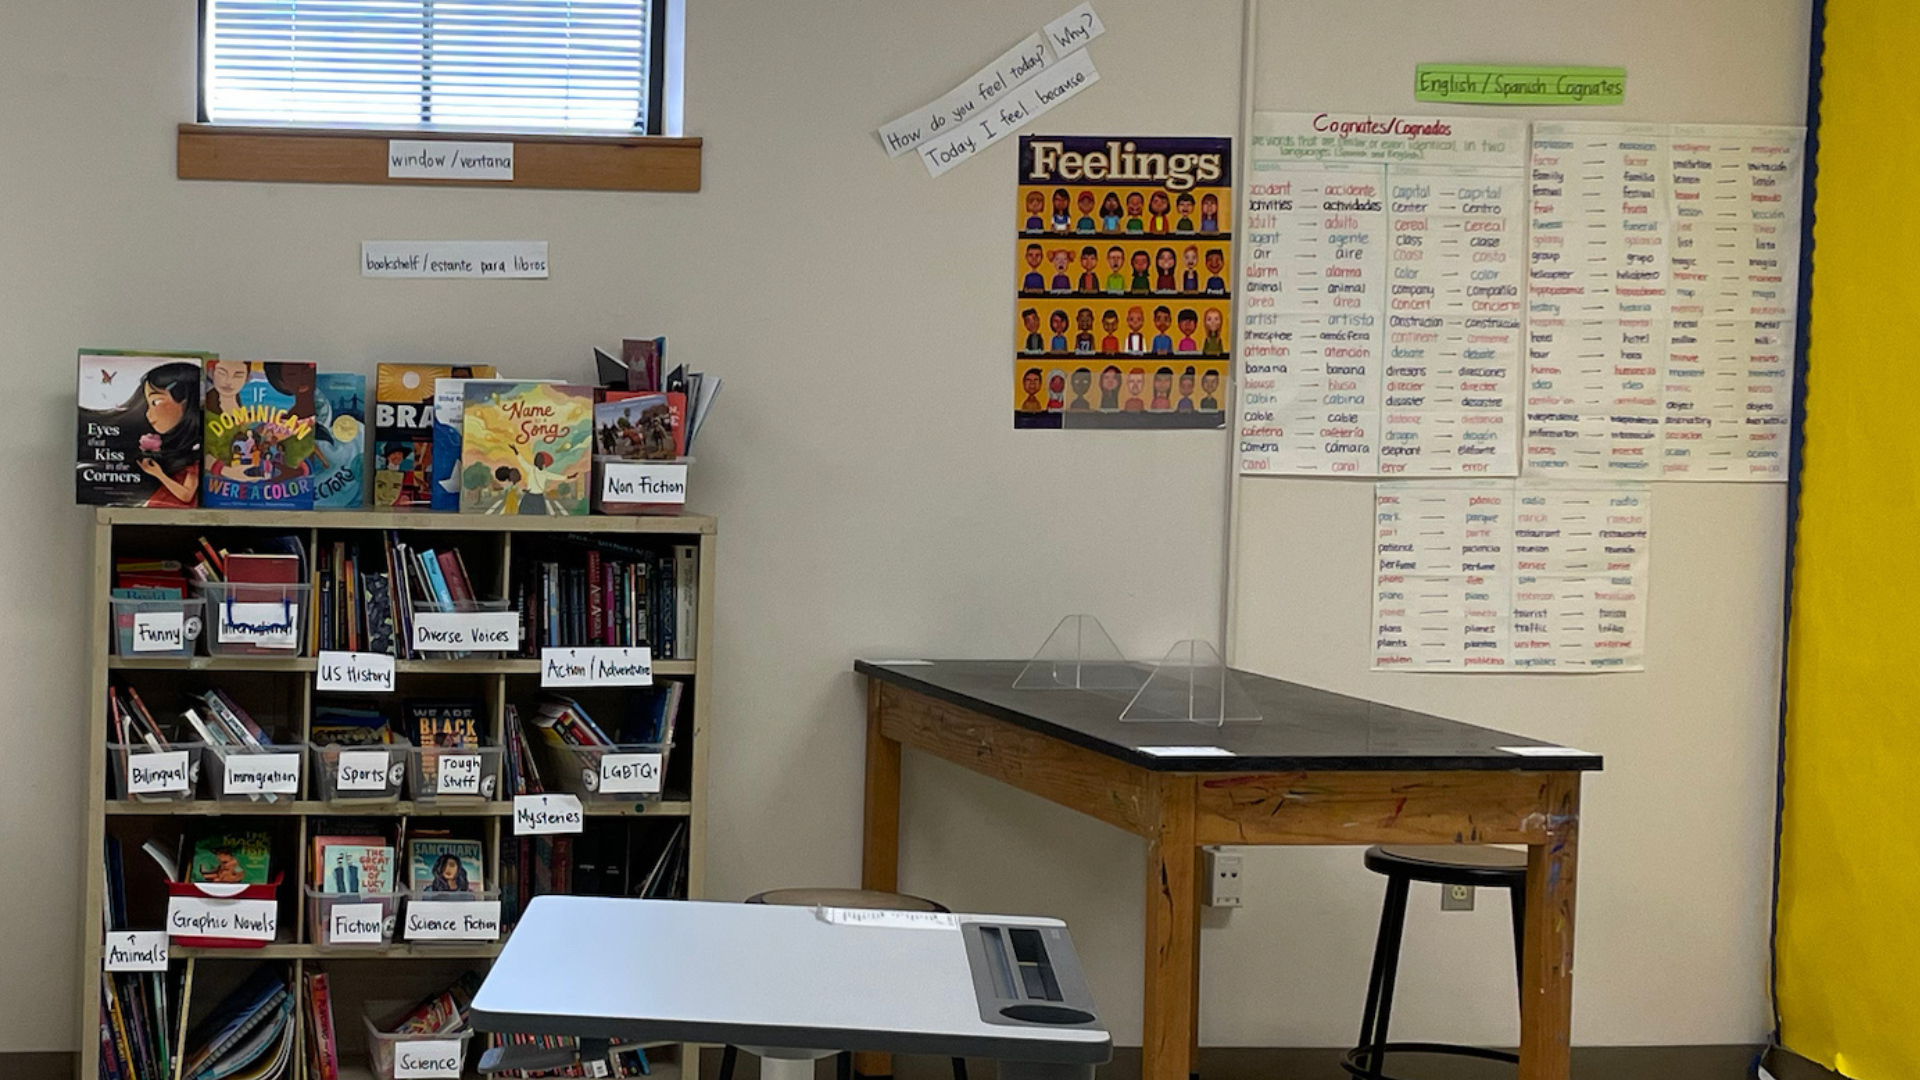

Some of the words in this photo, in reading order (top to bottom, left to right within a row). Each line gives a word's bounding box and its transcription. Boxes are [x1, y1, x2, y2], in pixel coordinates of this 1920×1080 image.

[887, 128, 921, 151] How
[930, 114, 946, 132] do
[951, 100, 975, 122] you
[978, 71, 1008, 100] feel
[1009, 44, 1045, 79] today?
[1053, 12, 1093, 48] Why?
[1420, 71, 1476, 97] English
[1557, 75, 1624, 101] Cognates
[979, 120, 998, 140] I
[1000, 101, 1030, 126] feel
[1035, 71, 1086, 105] because
[392, 149, 446, 168] window
[1029, 141, 1222, 191] Feelings
[1254, 249, 1271, 259] air
[1336, 249, 1363, 259] aire
[481, 259, 506, 275] para
[514, 255, 546, 270] libros
[1247, 281, 1282, 293] animal
[1328, 283, 1366, 294] animal
[1326, 363, 1365, 375] banana
[253, 387, 268, 403] IF
[502, 400, 555, 420] Name
[88, 422, 120, 437] Eyes
[208, 404, 312, 441] DOMINICAN
[515, 421, 570, 445] Song
[95, 448, 125, 461] Kiss
[83, 469, 141, 483] Corners
[608, 477, 634, 495] Non
[638, 476, 684, 494] Fiction
[208, 478, 248, 499] WERE
[251, 486, 260, 499] A
[264, 479, 311, 500] COLOR
[139, 624, 181, 644] Funny
[418, 627, 463, 643] Diverse
[472, 628, 509, 643] Voices
[322, 665, 342, 682] US
[347, 665, 391, 688] History
[548, 658, 586, 678] Action
[132, 761, 186, 787] Bilingual
[443, 758, 480, 772] Tough
[602, 763, 658, 780] LGBTQ+
[341, 766, 385, 784] Sports
[443, 775, 477, 788] Stuff
[414, 843, 479, 857] SANCTUARY
[361, 879, 387, 888] LUCY
[173, 909, 228, 934] Graphic
[234, 912, 275, 932] Novels
[335, 916, 380, 935] Fiction
[408, 913, 457, 931] Science
[464, 915, 497, 930] Fiction
[109, 945, 166, 965] Animals
[400, 1053, 459, 1071] Science
